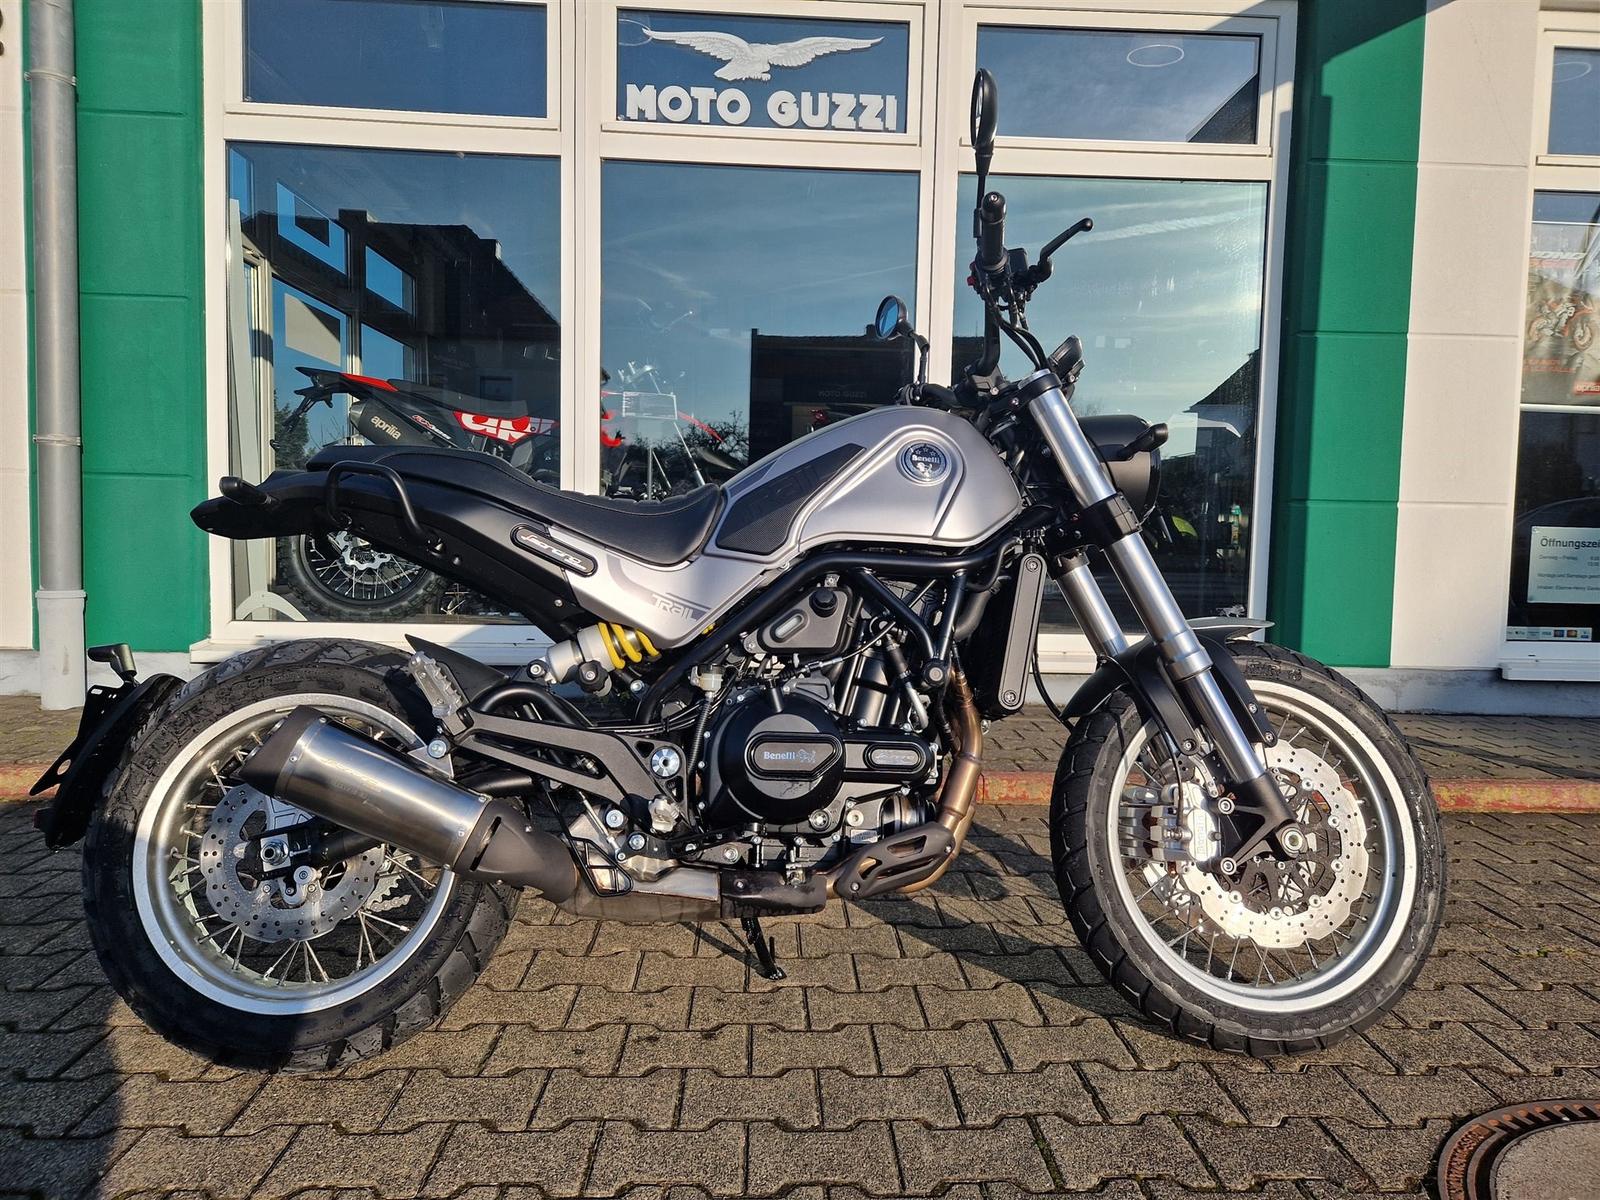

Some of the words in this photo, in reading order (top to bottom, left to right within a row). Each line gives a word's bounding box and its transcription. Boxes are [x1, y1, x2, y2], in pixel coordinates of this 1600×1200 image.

[626, 83, 751, 125] MOTO
[766, 90, 898, 131] GUZZI
[370, 415, 402, 440] aprilia
[911, 454, 940, 465] Benelli
[763, 751, 796, 760] Benelli
